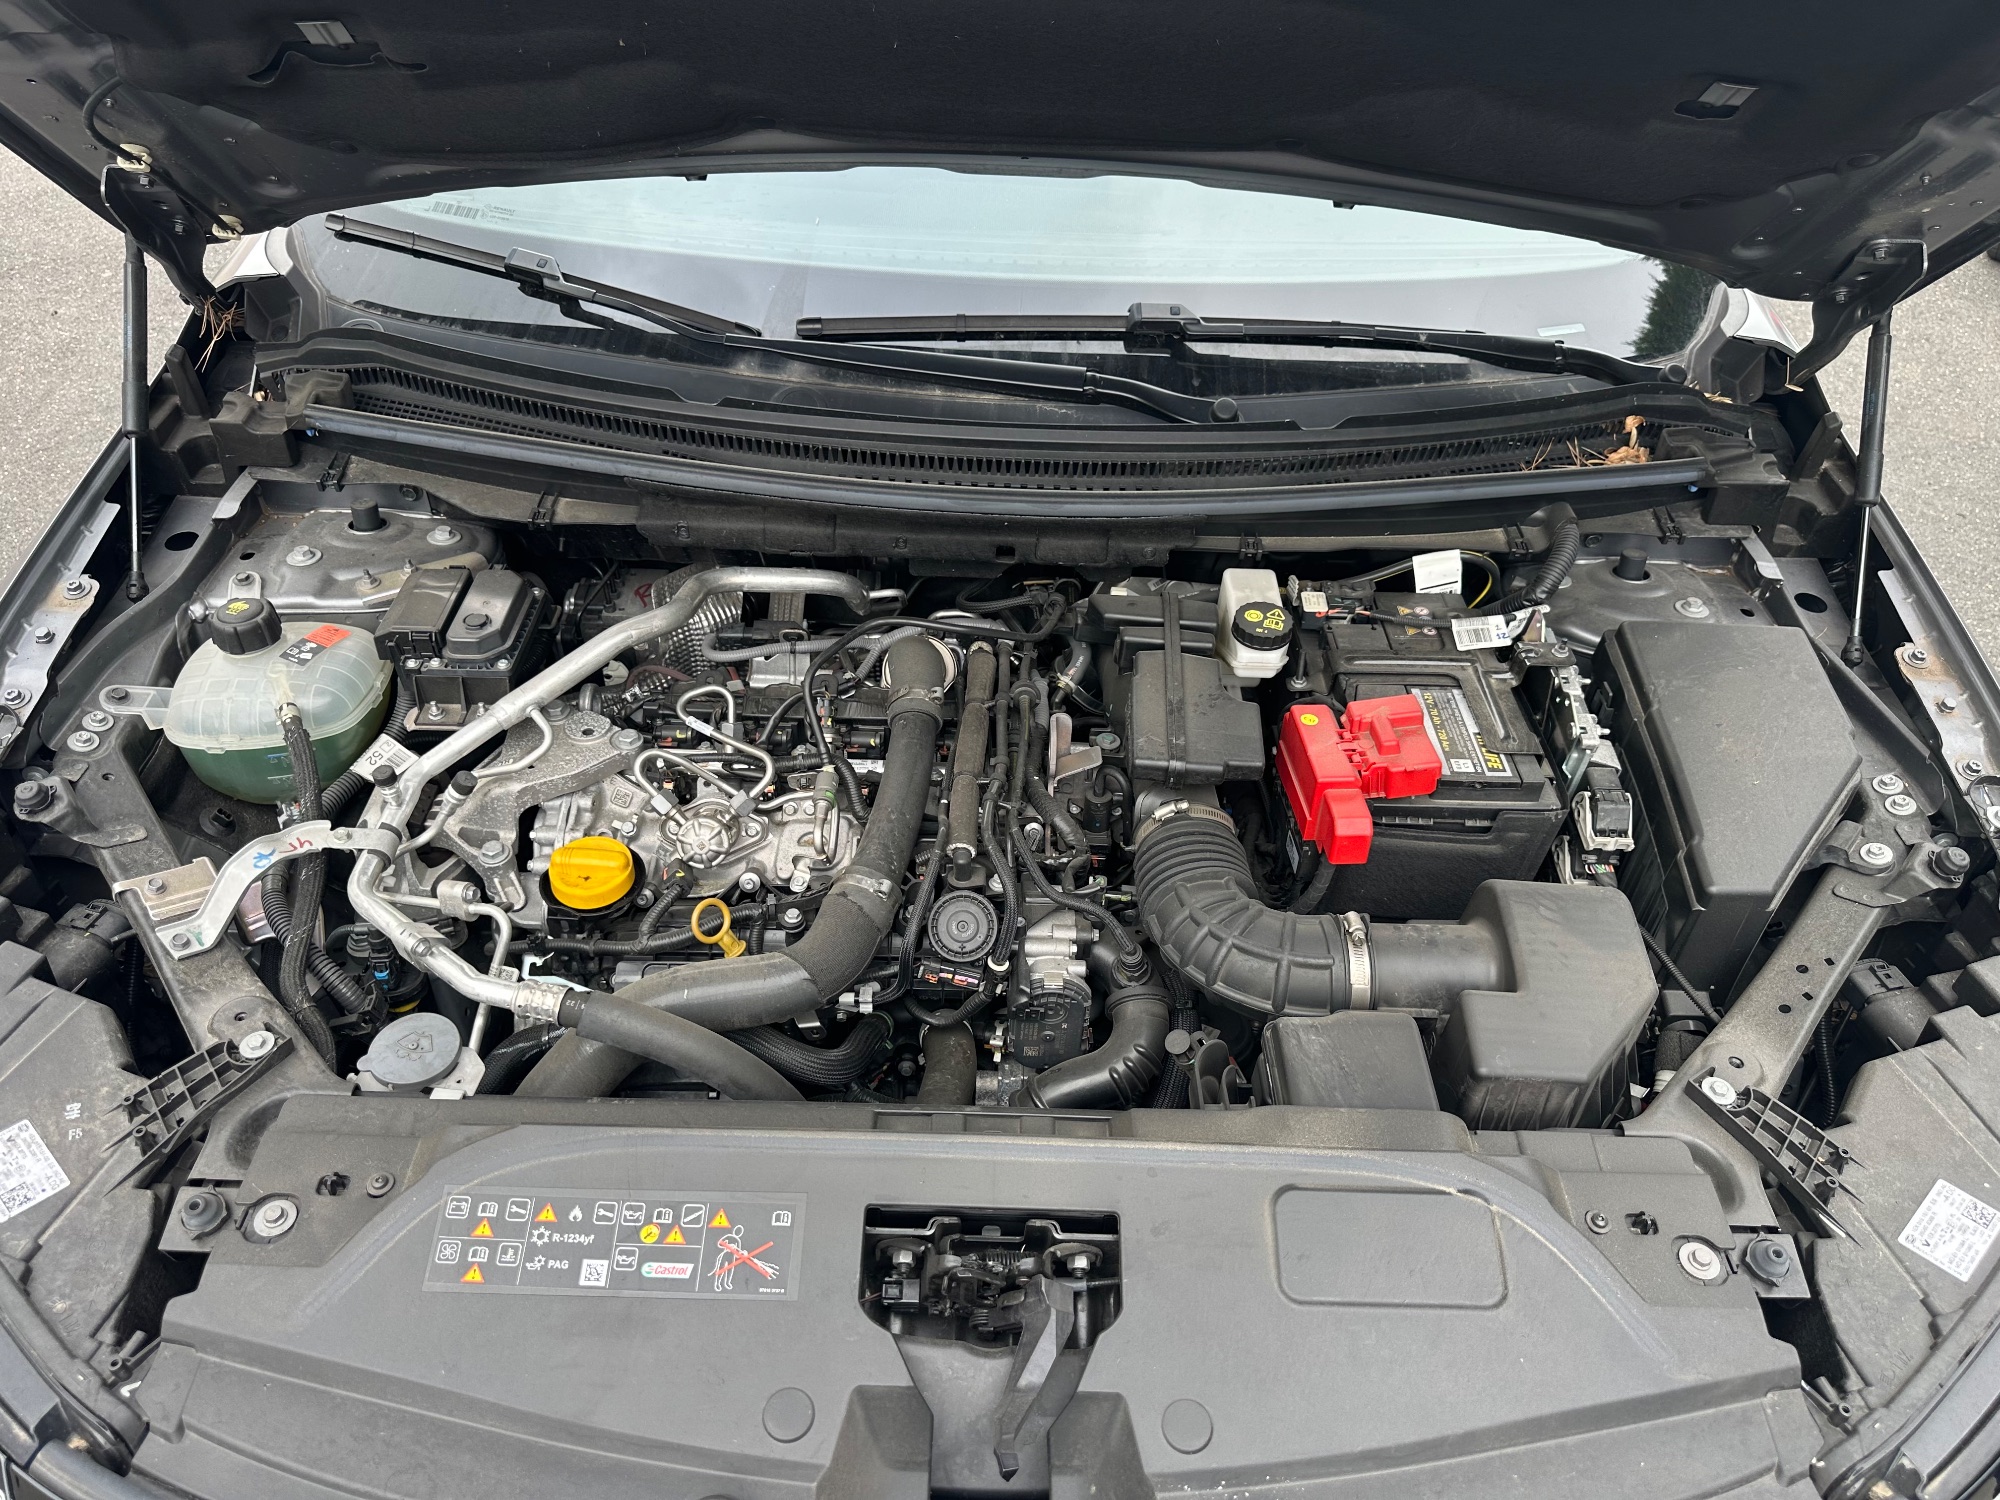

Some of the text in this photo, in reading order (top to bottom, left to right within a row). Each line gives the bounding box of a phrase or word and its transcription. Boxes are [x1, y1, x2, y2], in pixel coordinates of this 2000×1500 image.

[1424, 692, 1434, 705] 12V
[365, 751, 384, 766] 52
[552, 1233, 594, 1246] R-1234yf
[548, 1260, 569, 1269] PAG
[654, 1264, 688, 1276] Castrol
